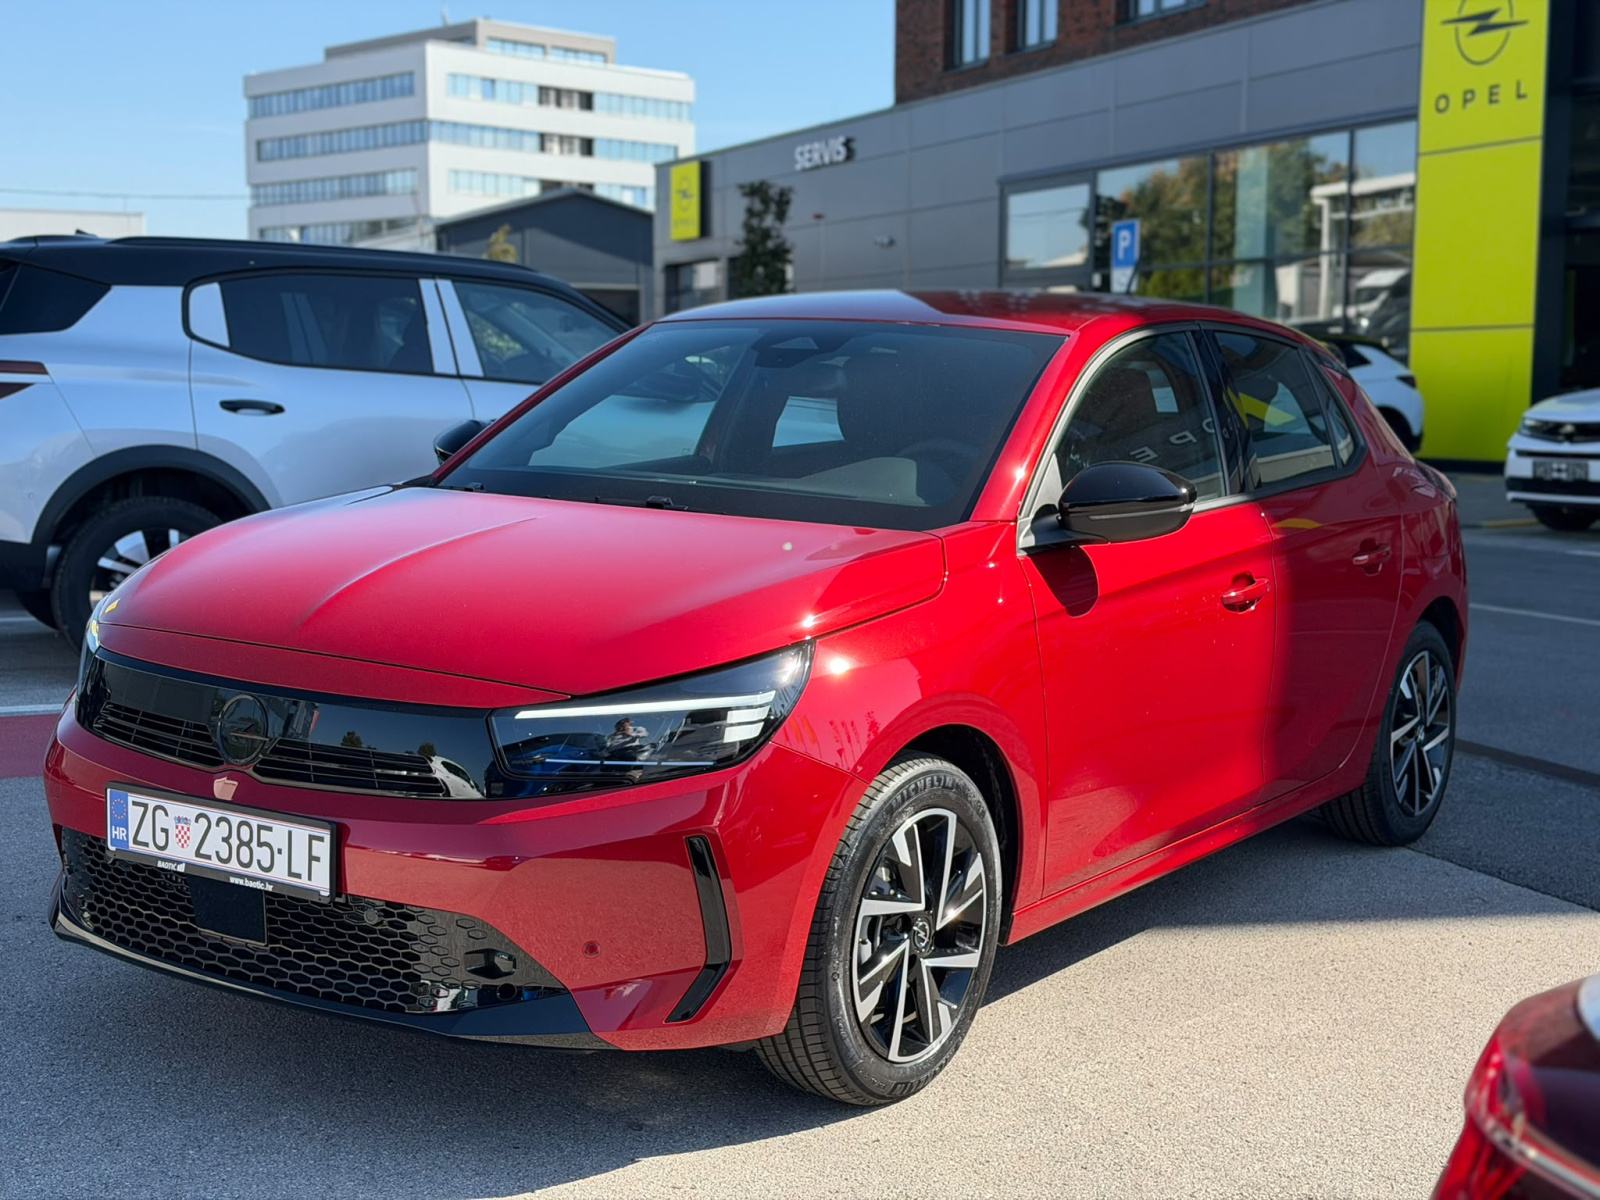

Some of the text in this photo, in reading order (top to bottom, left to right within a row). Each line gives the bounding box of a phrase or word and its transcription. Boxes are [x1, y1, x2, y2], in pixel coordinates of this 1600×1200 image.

[1434, 79, 1528, 114] OPEL
[794, 135, 847, 171] SERVIS
[1117, 229, 1132, 260] P
[111, 826, 127, 841] HR
[131, 800, 169, 851] ZG
[229, 876, 274, 892] www.baotic.hr
